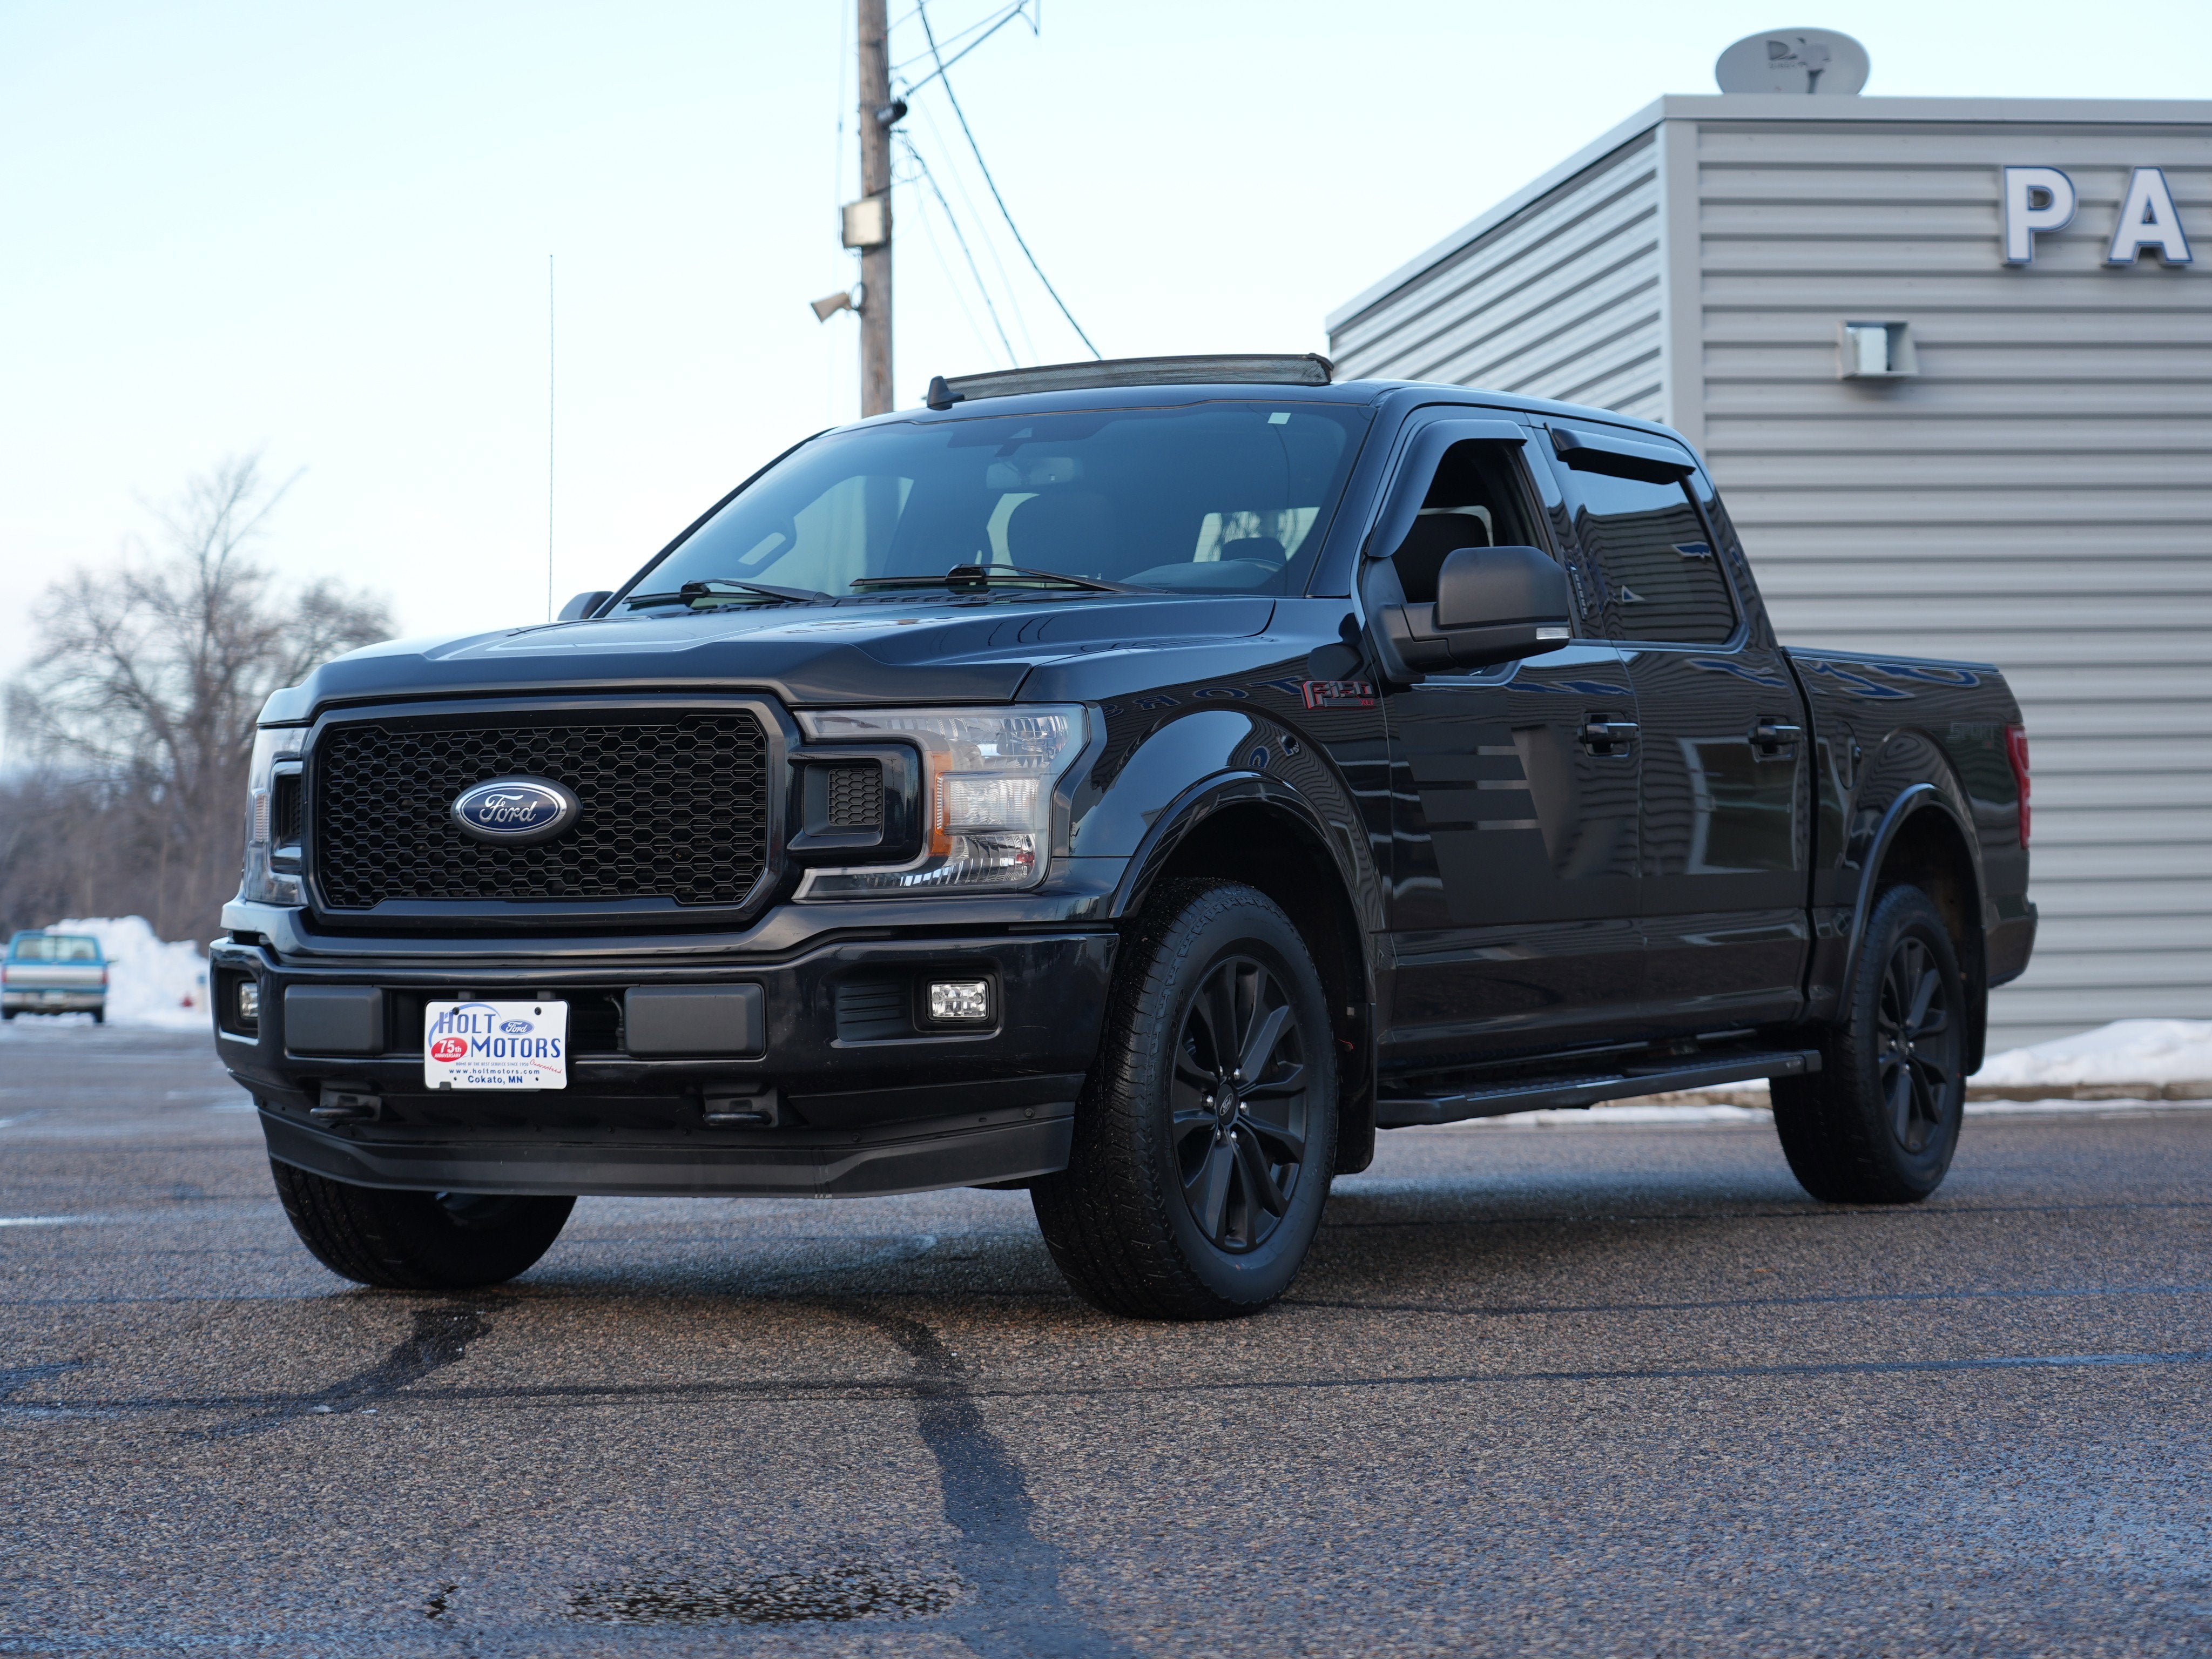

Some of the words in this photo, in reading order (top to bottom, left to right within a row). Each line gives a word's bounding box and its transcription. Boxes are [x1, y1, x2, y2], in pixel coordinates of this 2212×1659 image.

[1946, 721, 2000, 741] SPORT
[478, 793, 538, 823] Ford
[439, 1011, 496, 1034] HOLT
[505, 1021, 528, 1033] Ford
[439, 1040, 462, 1054] 75th
[471, 1035, 561, 1058] MOTORS
[530, 1058, 562, 1074] Guaranteed
[468, 1075, 505, 1085] Cokato,
[508, 1075, 523, 1083] MN
